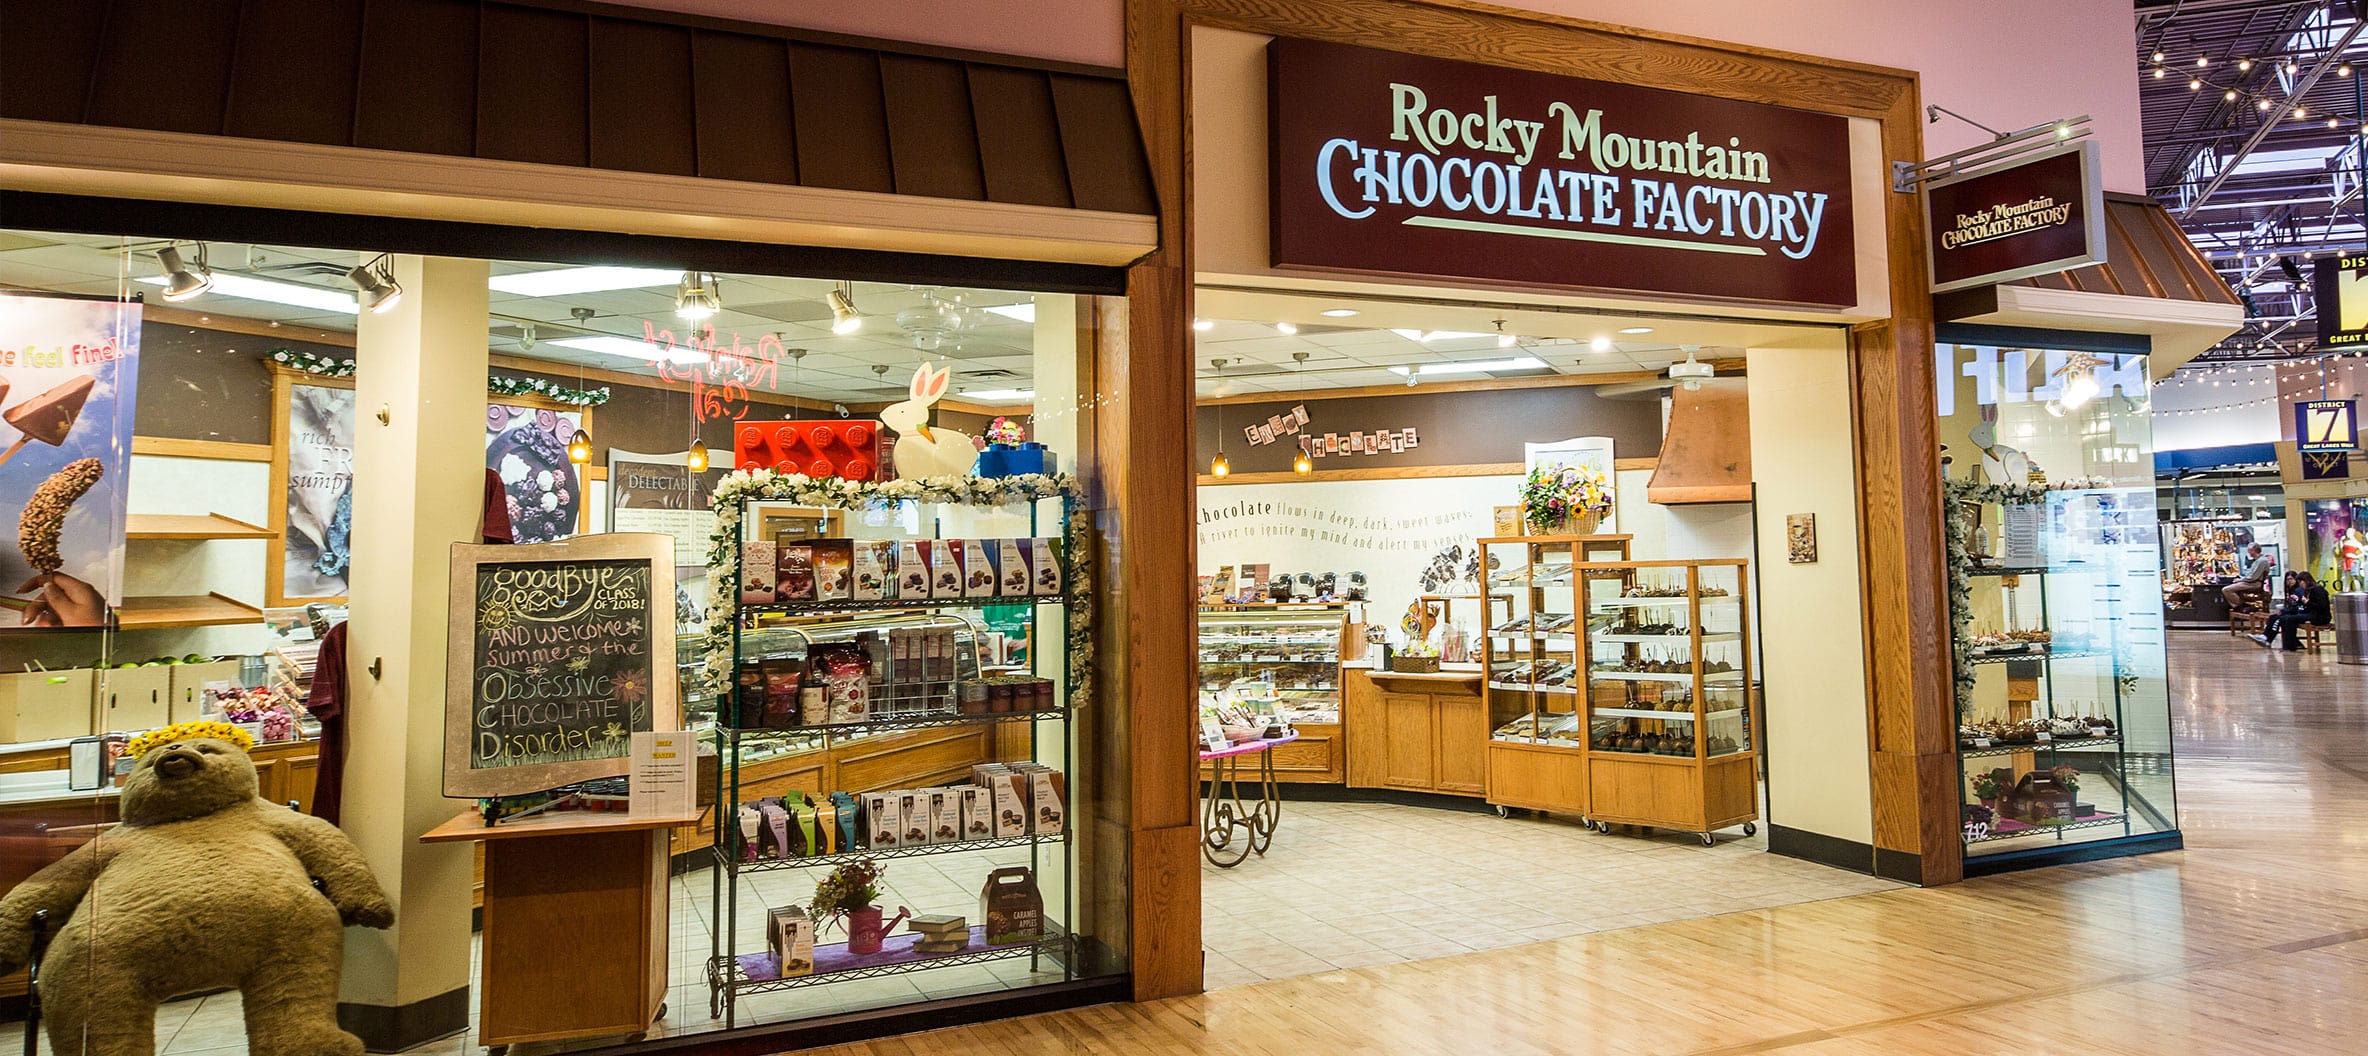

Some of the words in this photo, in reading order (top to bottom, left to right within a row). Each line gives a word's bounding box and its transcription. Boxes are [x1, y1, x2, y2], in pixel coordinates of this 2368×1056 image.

[1390, 83, 1544, 166] Rocky
[1548, 102, 1770, 184] Mountain
[1316, 138, 1621, 226] CHOCOLATE
[1631, 178, 1828, 260] FACTORY
[1956, 210, 1992, 229] Rocky
[1992, 196, 2053, 220] Mountain
[1941, 220, 2012, 250] CHOCOLATE
[2014, 202, 2072, 231] FACTORY
[2341, 257, 2368, 269] DIS
[2329, 334, 2362, 344] GREAT
[302, 428, 336, 445] rich
[2316, 409, 2341, 442] 7
[629, 475, 699, 490] DELECTABE
[1197, 500, 1271, 525] hocolate
[1277, 502, 1307, 517] flows
[1313, 507, 1324, 520] in
[1211, 528, 1238, 542] river
[1244, 526, 1255, 536] to
[1261, 523, 1295, 537] ignite
[1301, 527, 1315, 541] my
[1321, 530, 1348, 545] mind
[1353, 536, 1372, 549] and
[1379, 537, 1407, 550] alert
[1413, 540, 1428, 551] my
[598, 587, 636, 601] CLASS
[609, 599, 645, 611] 2018!
[489, 625, 531, 648] AND
[601, 641, 645, 655] the
[482, 672, 614, 703] Obsessive
[477, 698, 619, 728] CHOCOLATE
[480, 725, 598, 760] Disorder
[1964, 822, 1988, 842] 712
[1013, 910, 1037, 919] CARAMEL
[1019, 919, 1037, 928] APPLES
